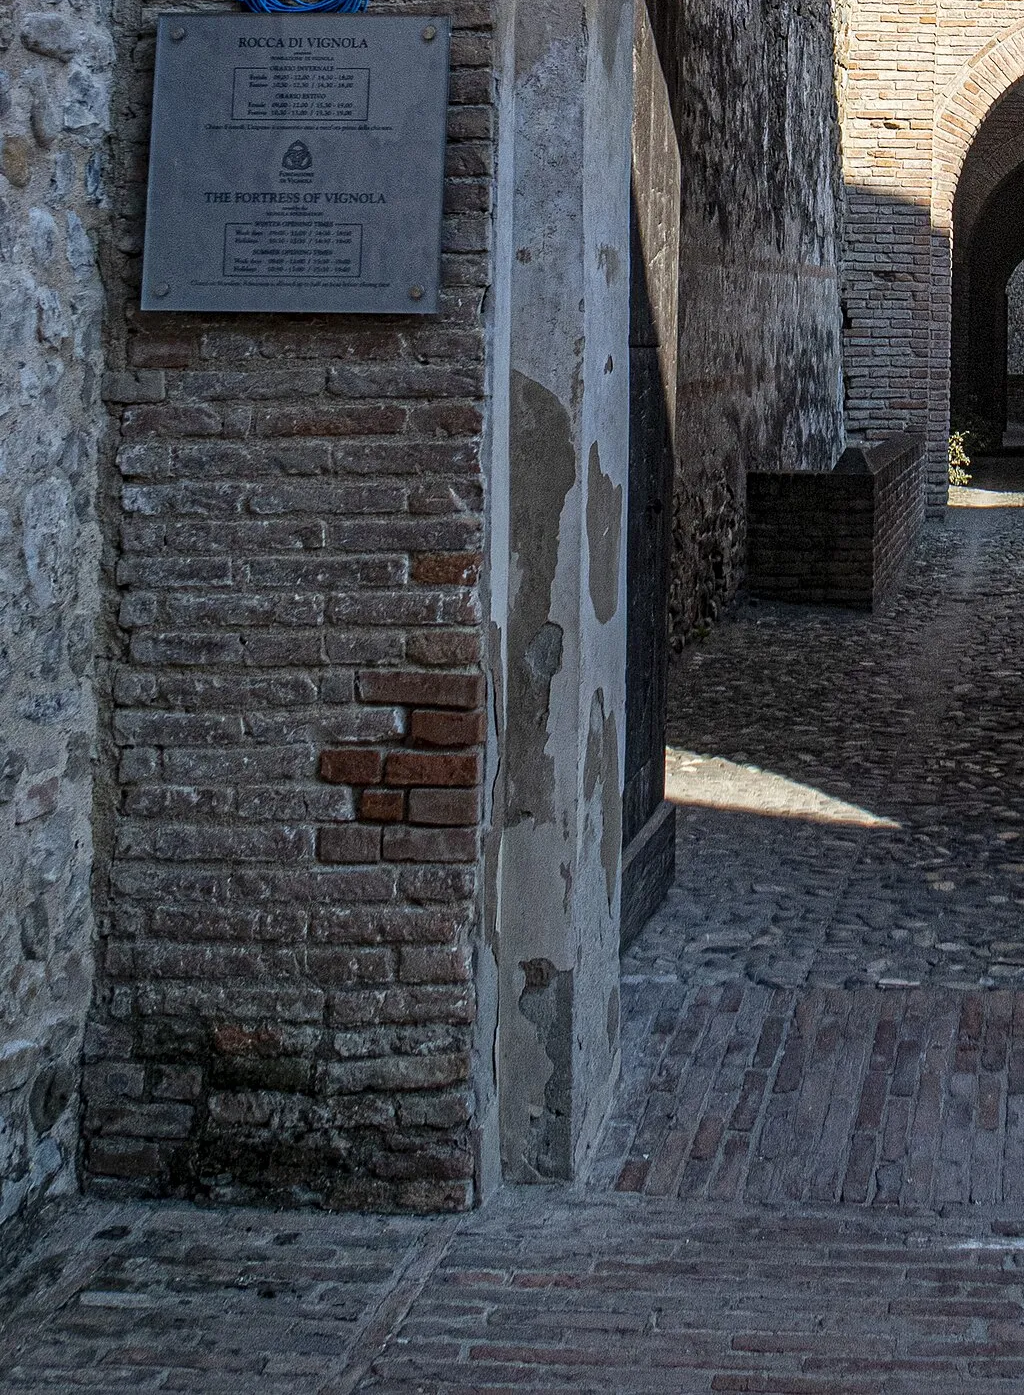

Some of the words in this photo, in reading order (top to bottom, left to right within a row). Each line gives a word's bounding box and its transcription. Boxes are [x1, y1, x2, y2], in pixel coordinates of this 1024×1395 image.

[238, 37, 285, 48] ROCCA
[289, 37, 303, 48] DI
[307, 37, 368, 49] VIGNOLA
[203, 192, 231, 203] THE
[235, 192, 300, 204] FORTRESS
[303, 192, 321, 204] OF
[325, 192, 386, 204] VIGNOLA
